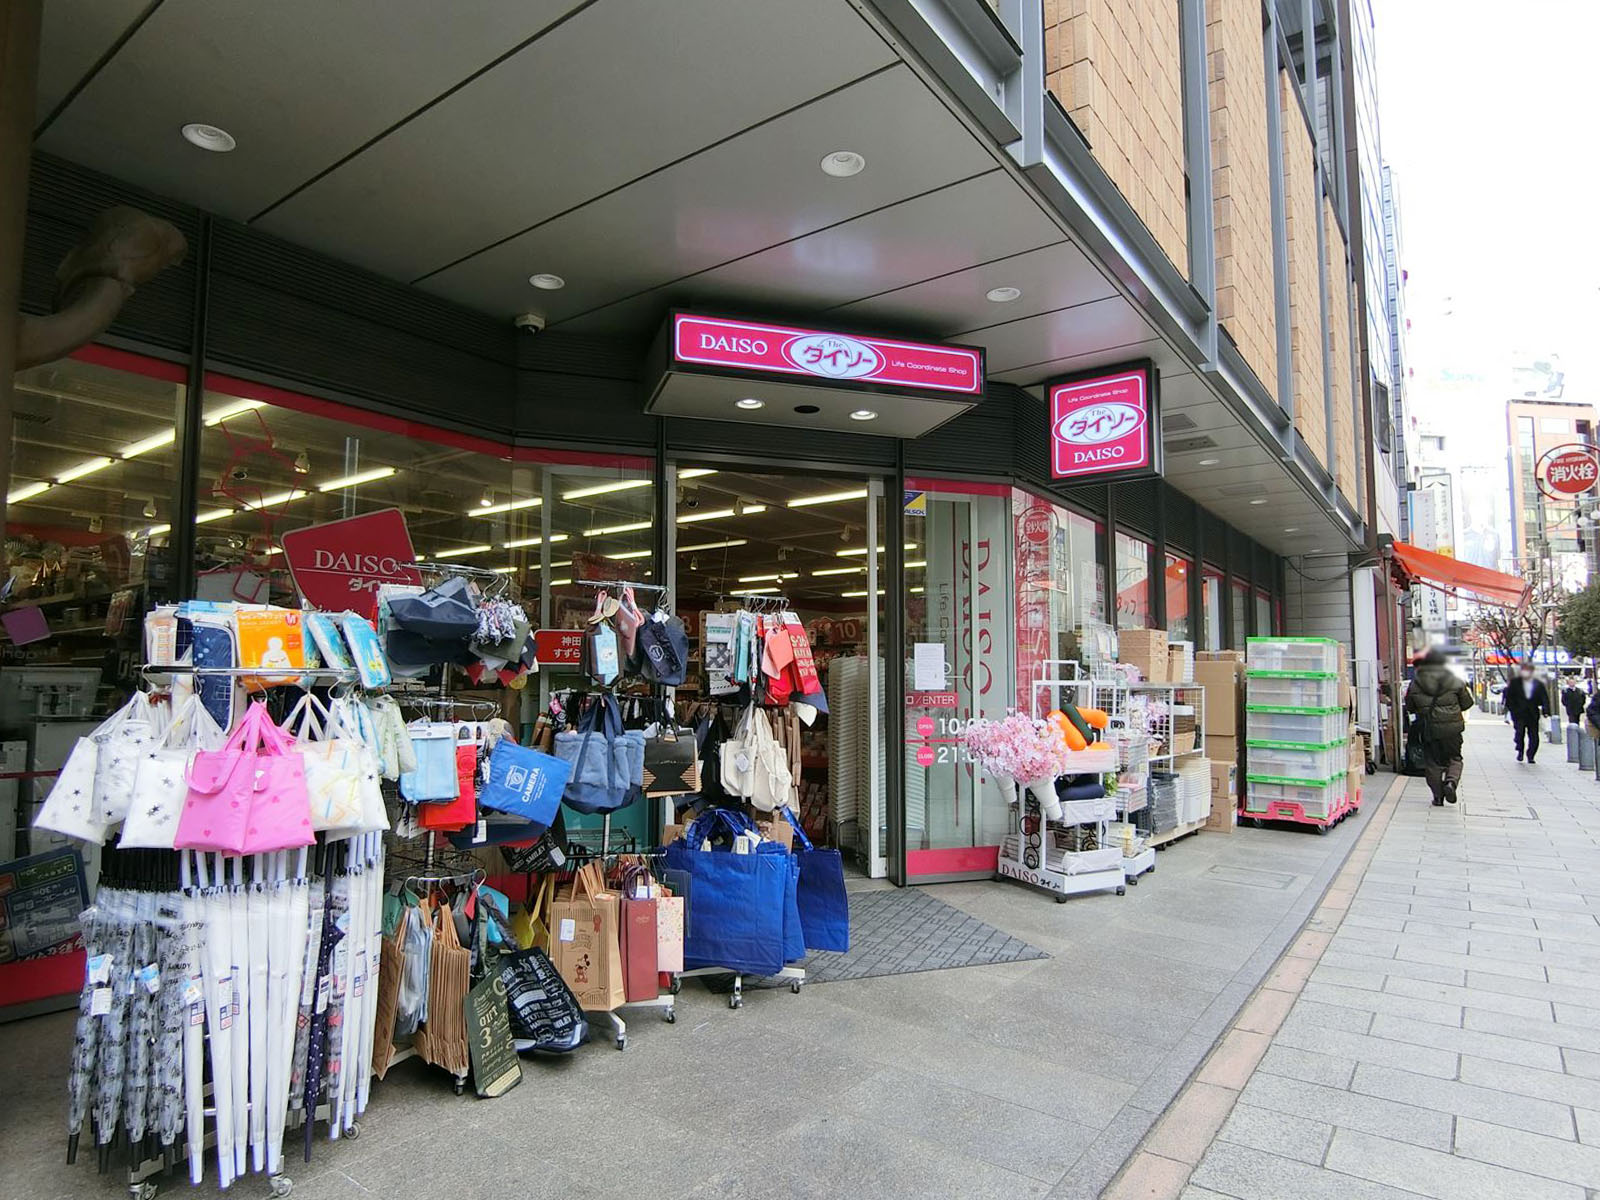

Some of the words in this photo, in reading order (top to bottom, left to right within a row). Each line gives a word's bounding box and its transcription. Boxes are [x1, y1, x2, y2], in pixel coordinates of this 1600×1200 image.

[700, 333, 768, 356] DAISO
[828, 339, 843, 348] The
[803, 345, 873, 368] ダイソー
[891, 359, 905, 368] Life
[906, 361, 947, 373] Coordinate
[948, 366, 967, 376] Shop
[1070, 412, 1135, 437] ダイソー
[1074, 446, 1125, 464] DAISO
[1550, 462, 1596, 483] 消火栓
[314, 549, 398, 575] DAISO
[835, 621, 857, 639] 10
[561, 636, 581, 646] 神田
[522, 767, 541, 803] CAMERA
[1002, 864, 1039, 884] DAISO
[479, 1027, 493, 1049] 3
